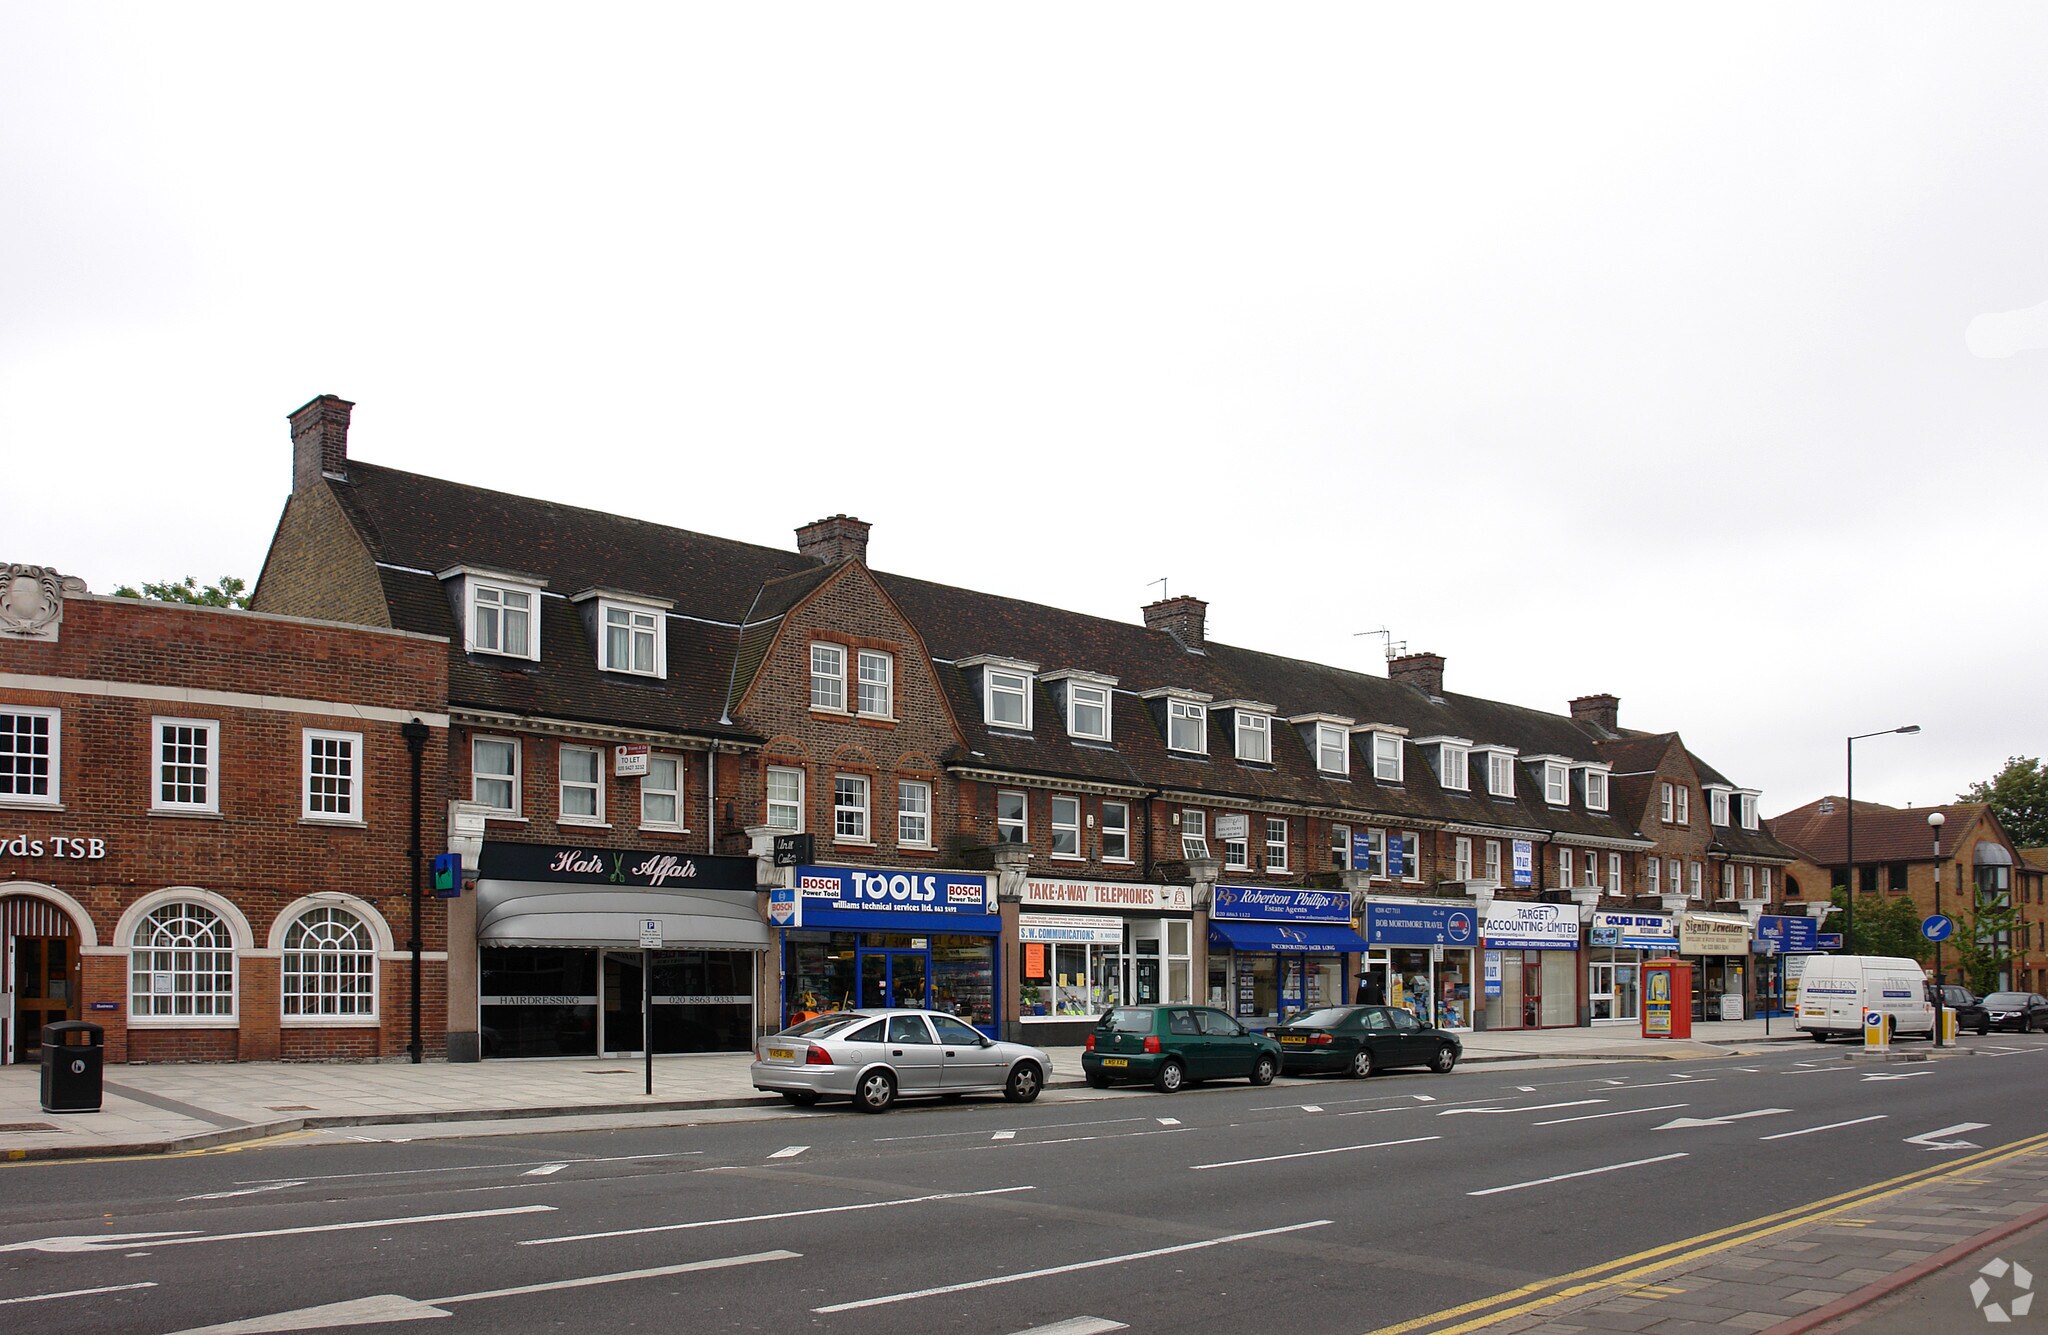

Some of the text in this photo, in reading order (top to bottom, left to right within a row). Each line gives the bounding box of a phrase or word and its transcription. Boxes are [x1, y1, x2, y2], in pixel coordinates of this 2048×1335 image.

[50, 836, 106, 859] TSB
[1515, 842, 1530, 853] OFFICES
[1516, 857, 1521, 866] TO
[550, 850, 696, 886] Hair Affair
[803, 878, 839, 890] BOSCH
[852, 872, 936, 901] TOOLS
[950, 886, 981, 897] BOSCH
[1095, 886, 1154, 904] TELEPHONES
[1240, 890, 1330, 909] Robertson Phillips
[772, 903, 792, 911] BOSCH
[833, 901, 860, 910] williams
[862, 902, 892, 911] technical
[1285, 906, 1307, 914] Agents
[1517, 909, 1549, 920] TARGET
[1389, 920, 1424, 928] MORTIMORE
[1486, 920, 1578, 932] ACCOUNTING LIMITED
[1606, 916, 1662, 927] GOLDEN KITCHEN
[1686, 920, 1742, 934] Signity Jewellers
[1038, 928, 1094, 940] COMMUNICATIONS
[1763, 927, 1779, 936] Anglian
[1485, 951, 1499, 961] FFICES
[1808, 980, 1857, 989] AITKEN
[1883, 978, 1910, 990] AITKEN
[500, 996, 580, 1005] HAIRDRESSING
